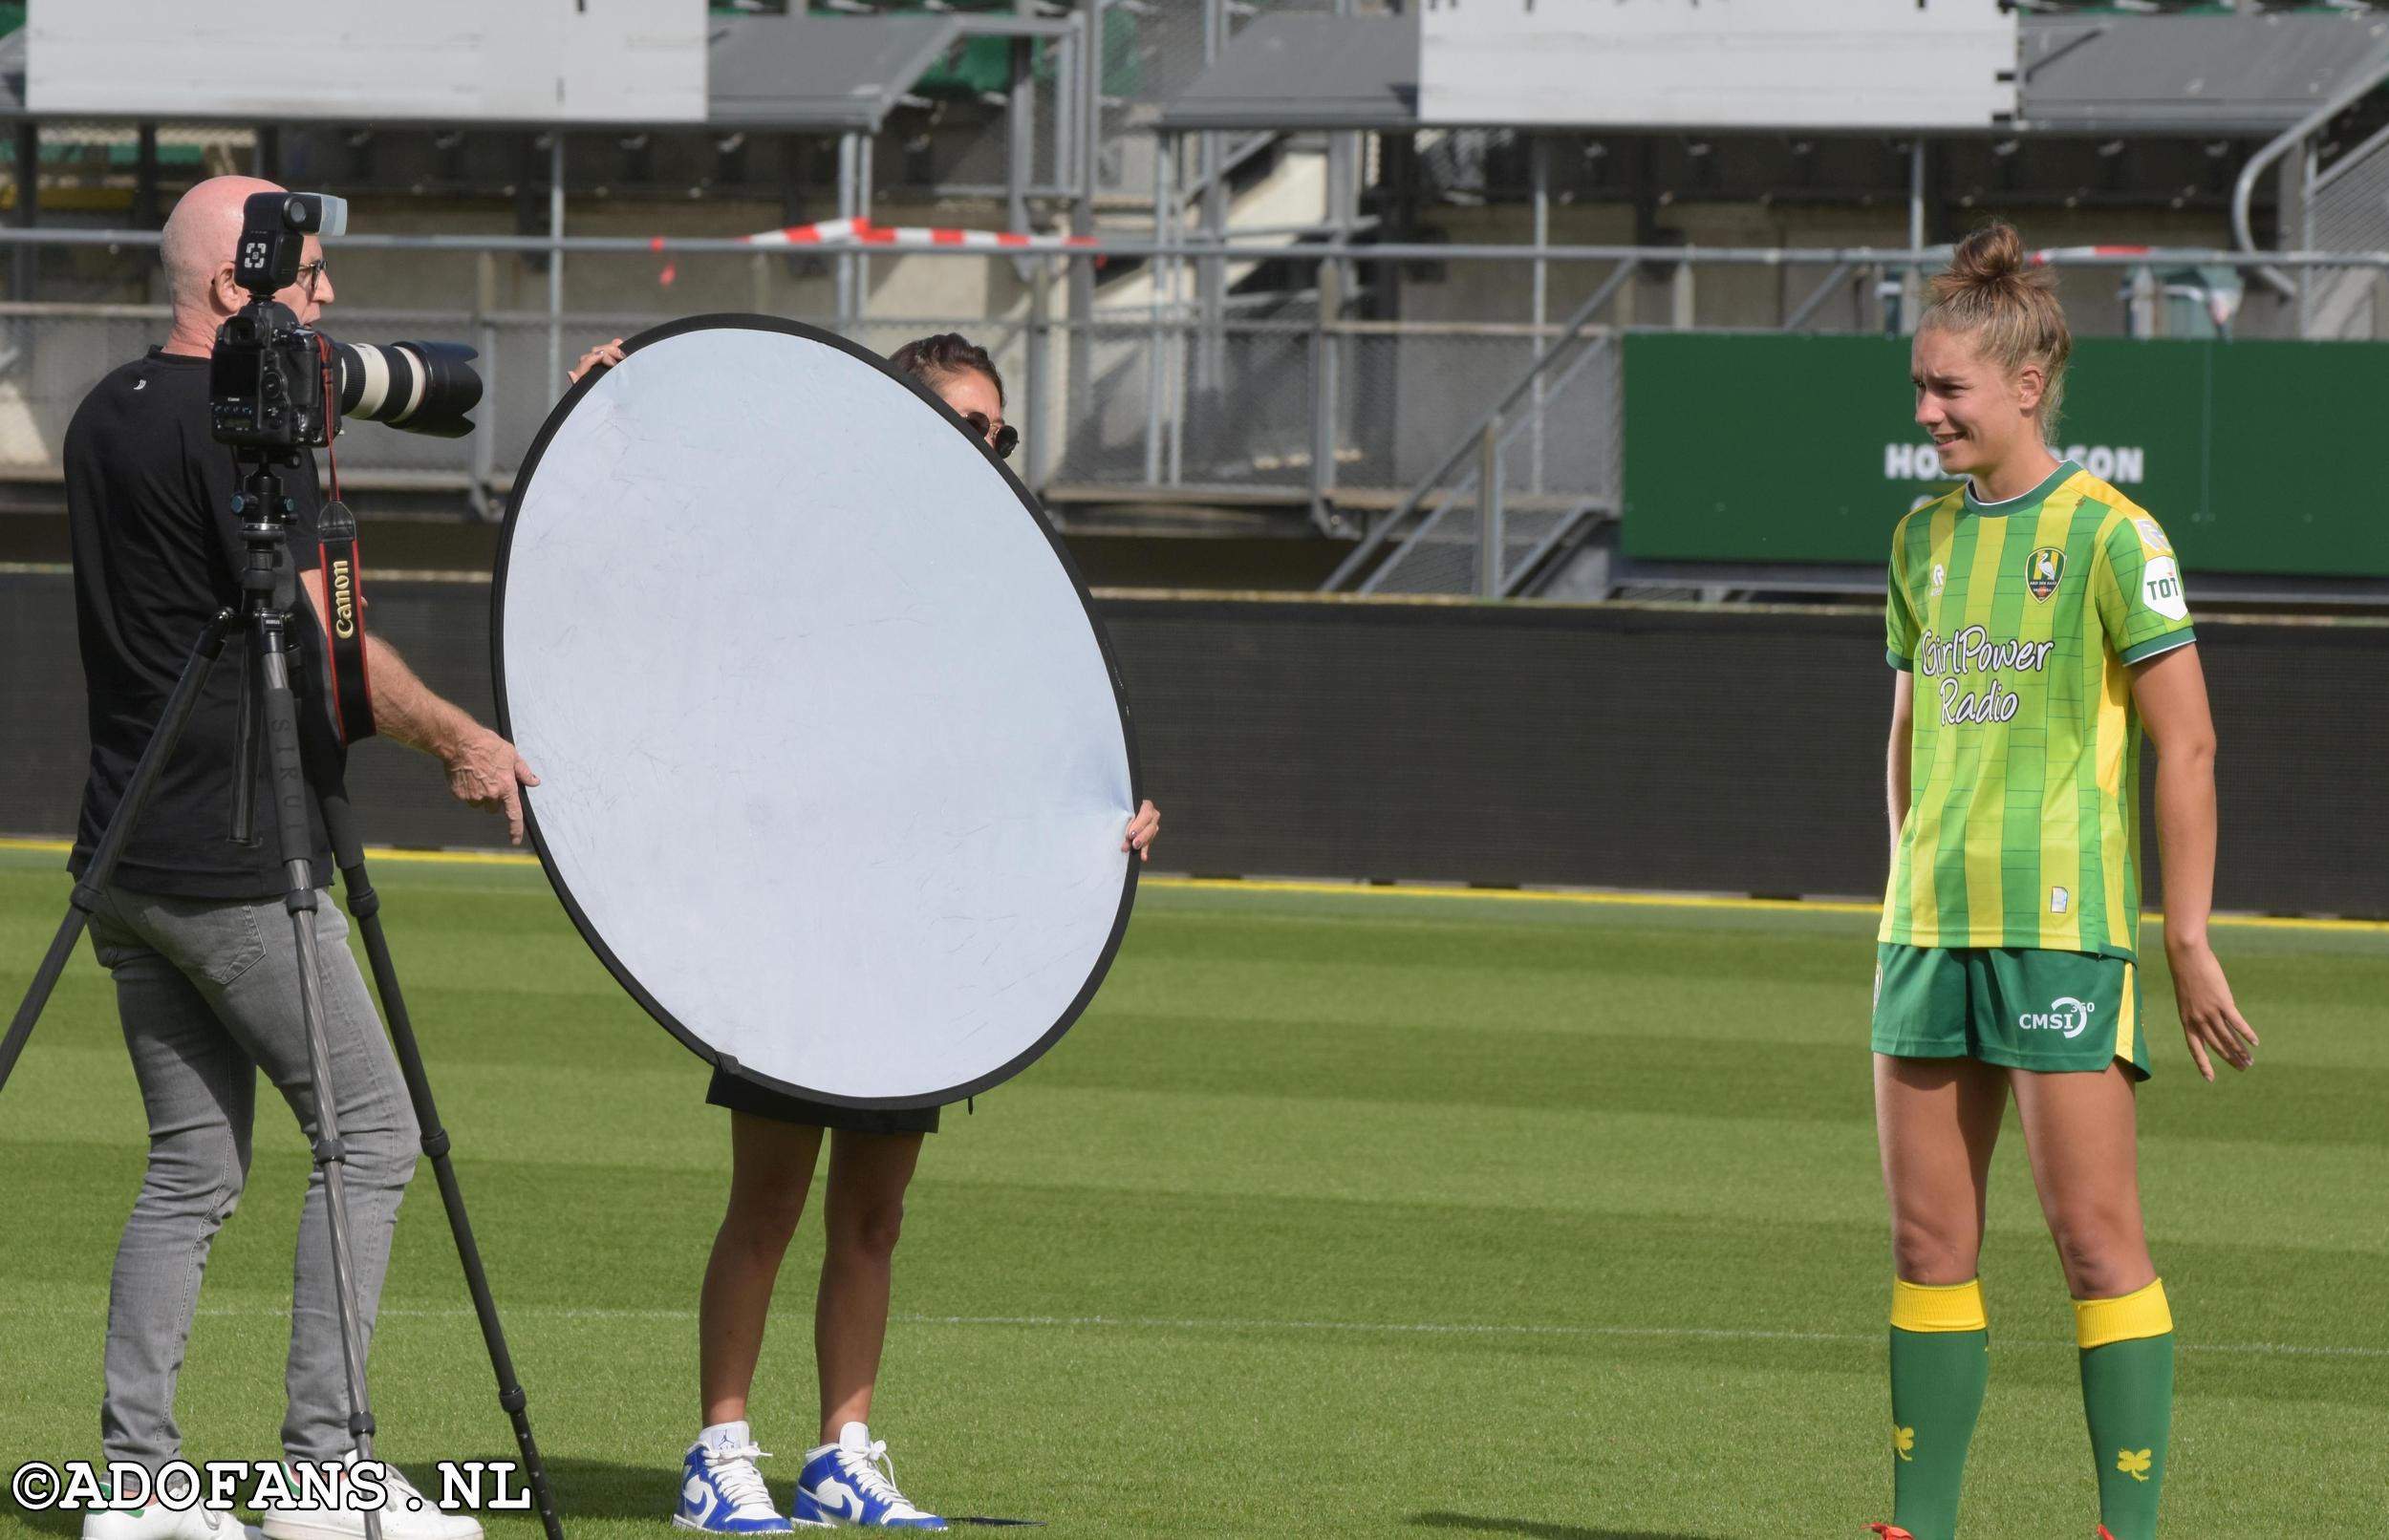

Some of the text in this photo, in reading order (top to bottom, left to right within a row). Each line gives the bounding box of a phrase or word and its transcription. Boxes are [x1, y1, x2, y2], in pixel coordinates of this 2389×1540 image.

[333, 560, 354, 639] Canon
[1921, 624, 2055, 679] GirlPower
[1939, 676, 2019, 726] Radio
[2018, 1013, 2074, 1030] CMSI
